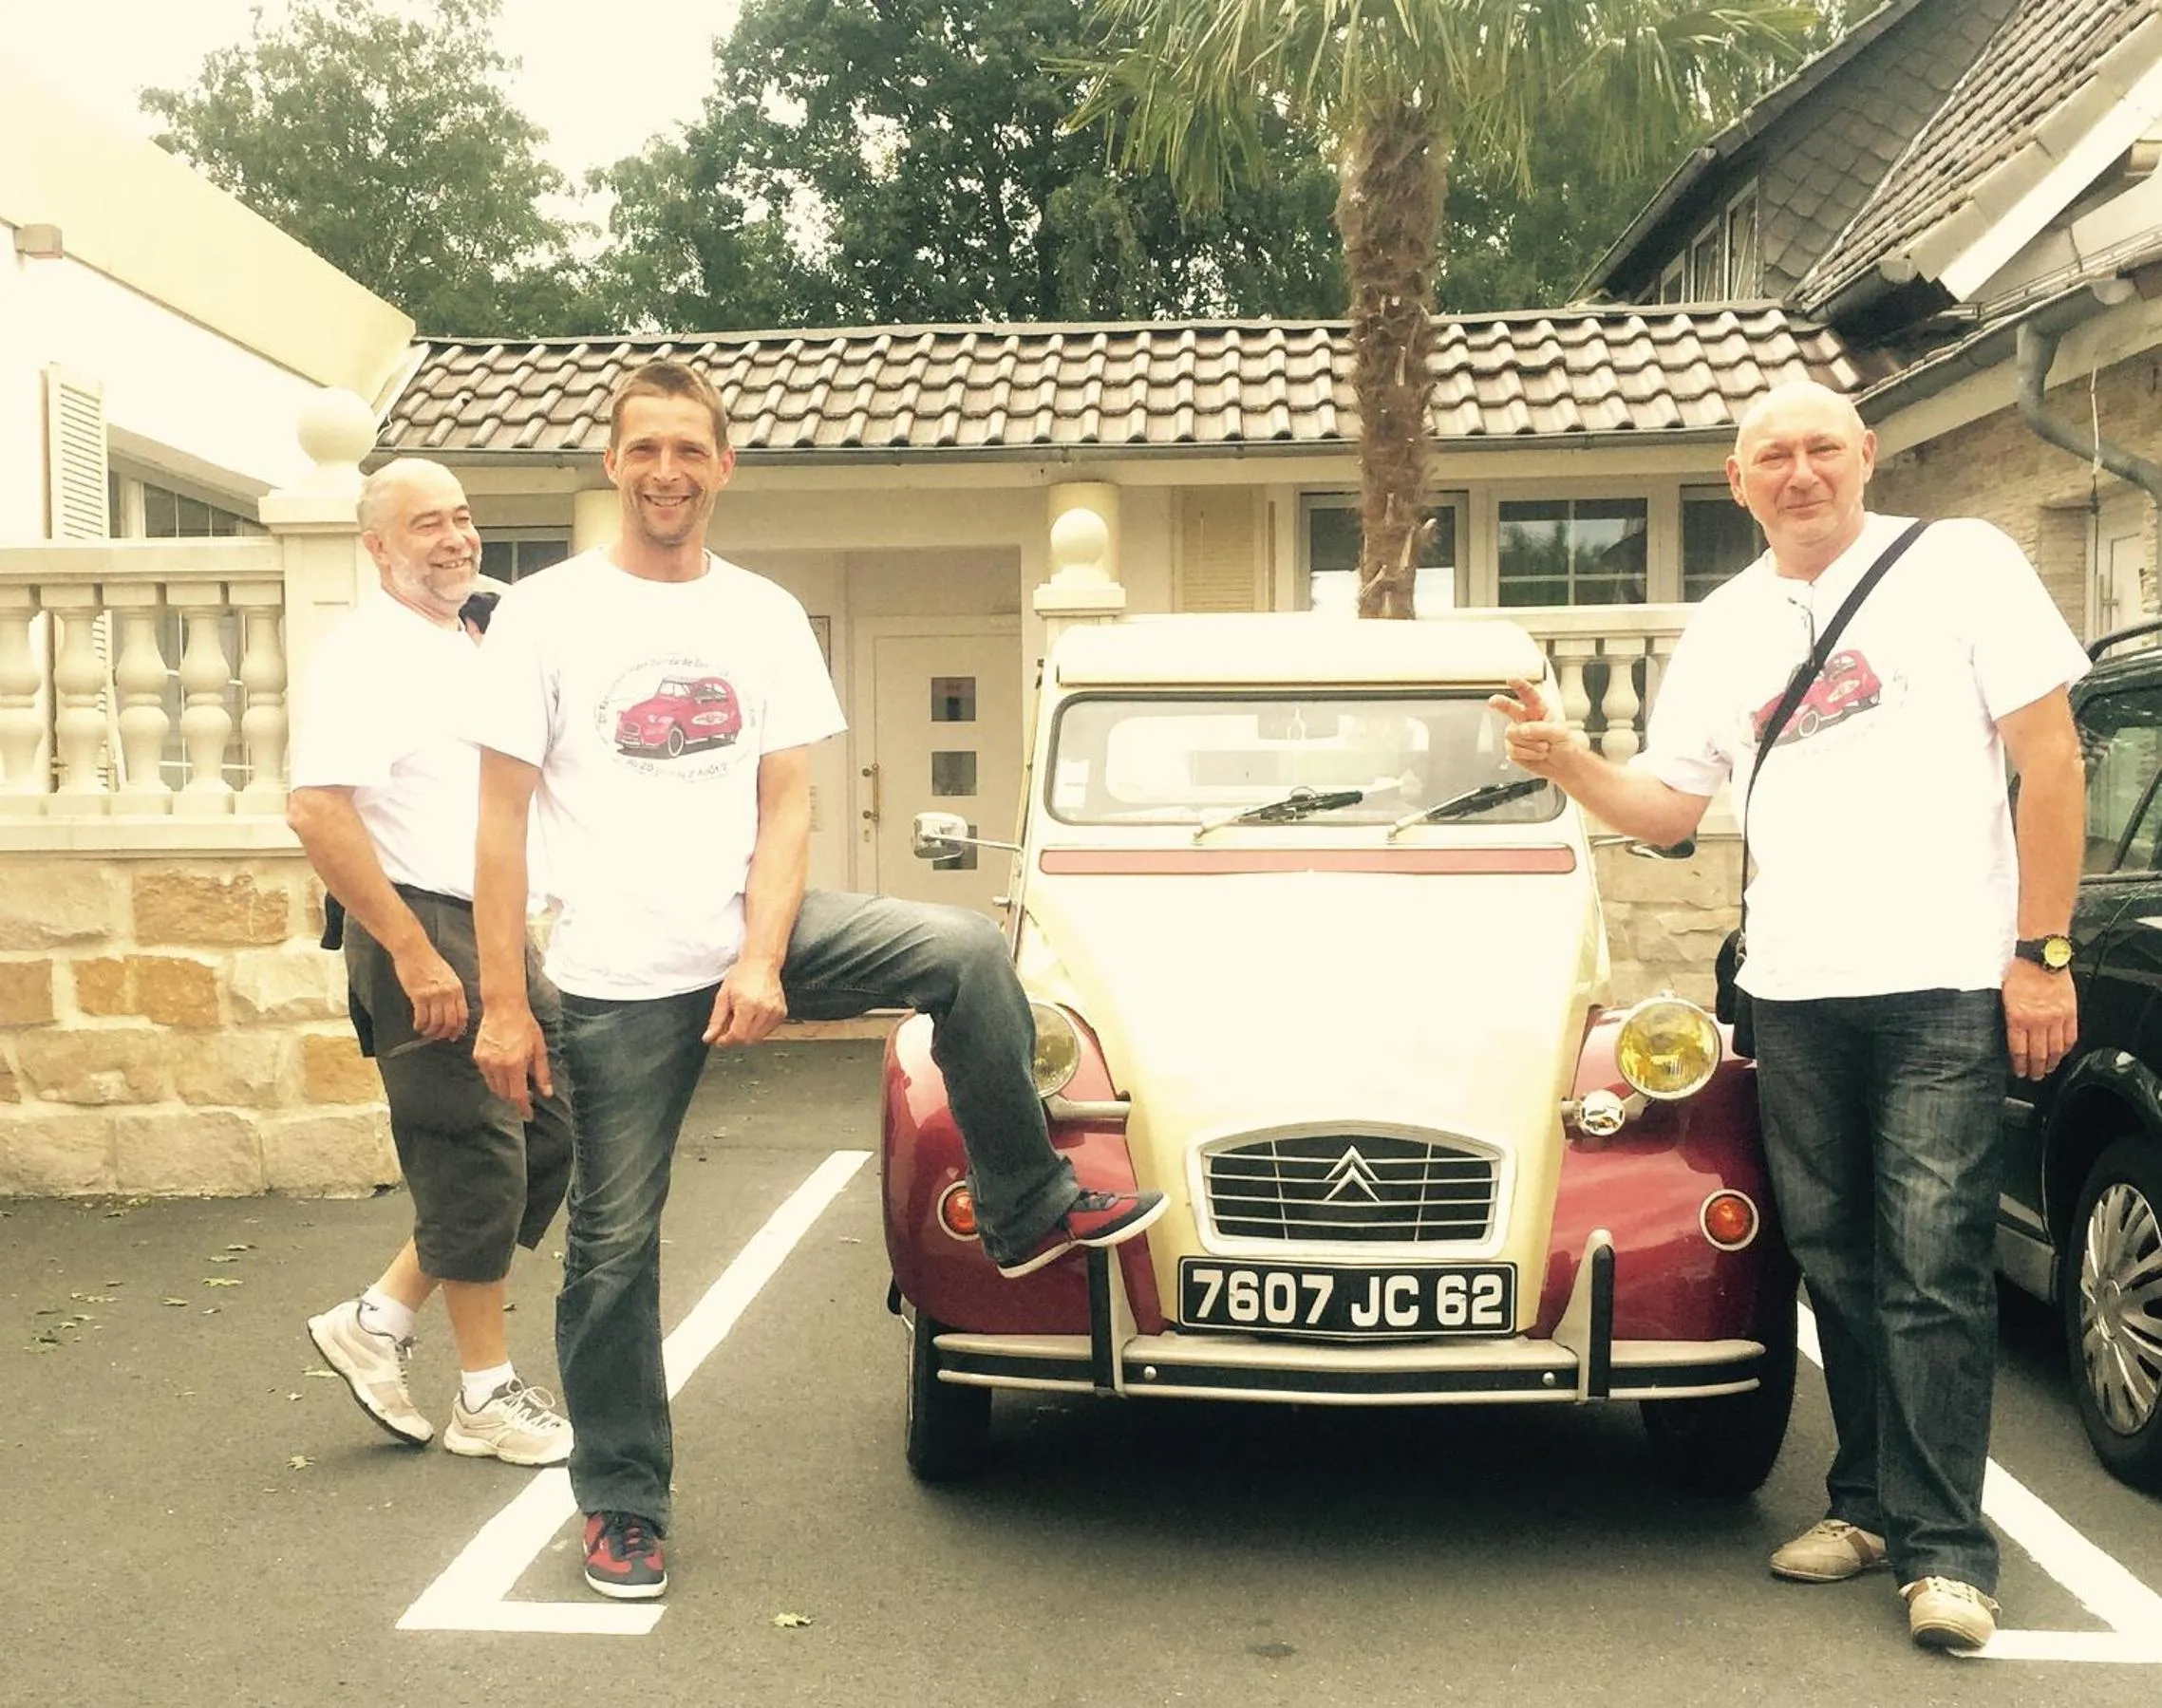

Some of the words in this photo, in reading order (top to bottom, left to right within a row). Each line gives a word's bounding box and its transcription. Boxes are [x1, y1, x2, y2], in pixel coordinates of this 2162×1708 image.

[1193, 1268, 1333, 1324] 7607
[1350, 1274, 1419, 1327] JC
[1437, 1273, 1503, 1326] 62
